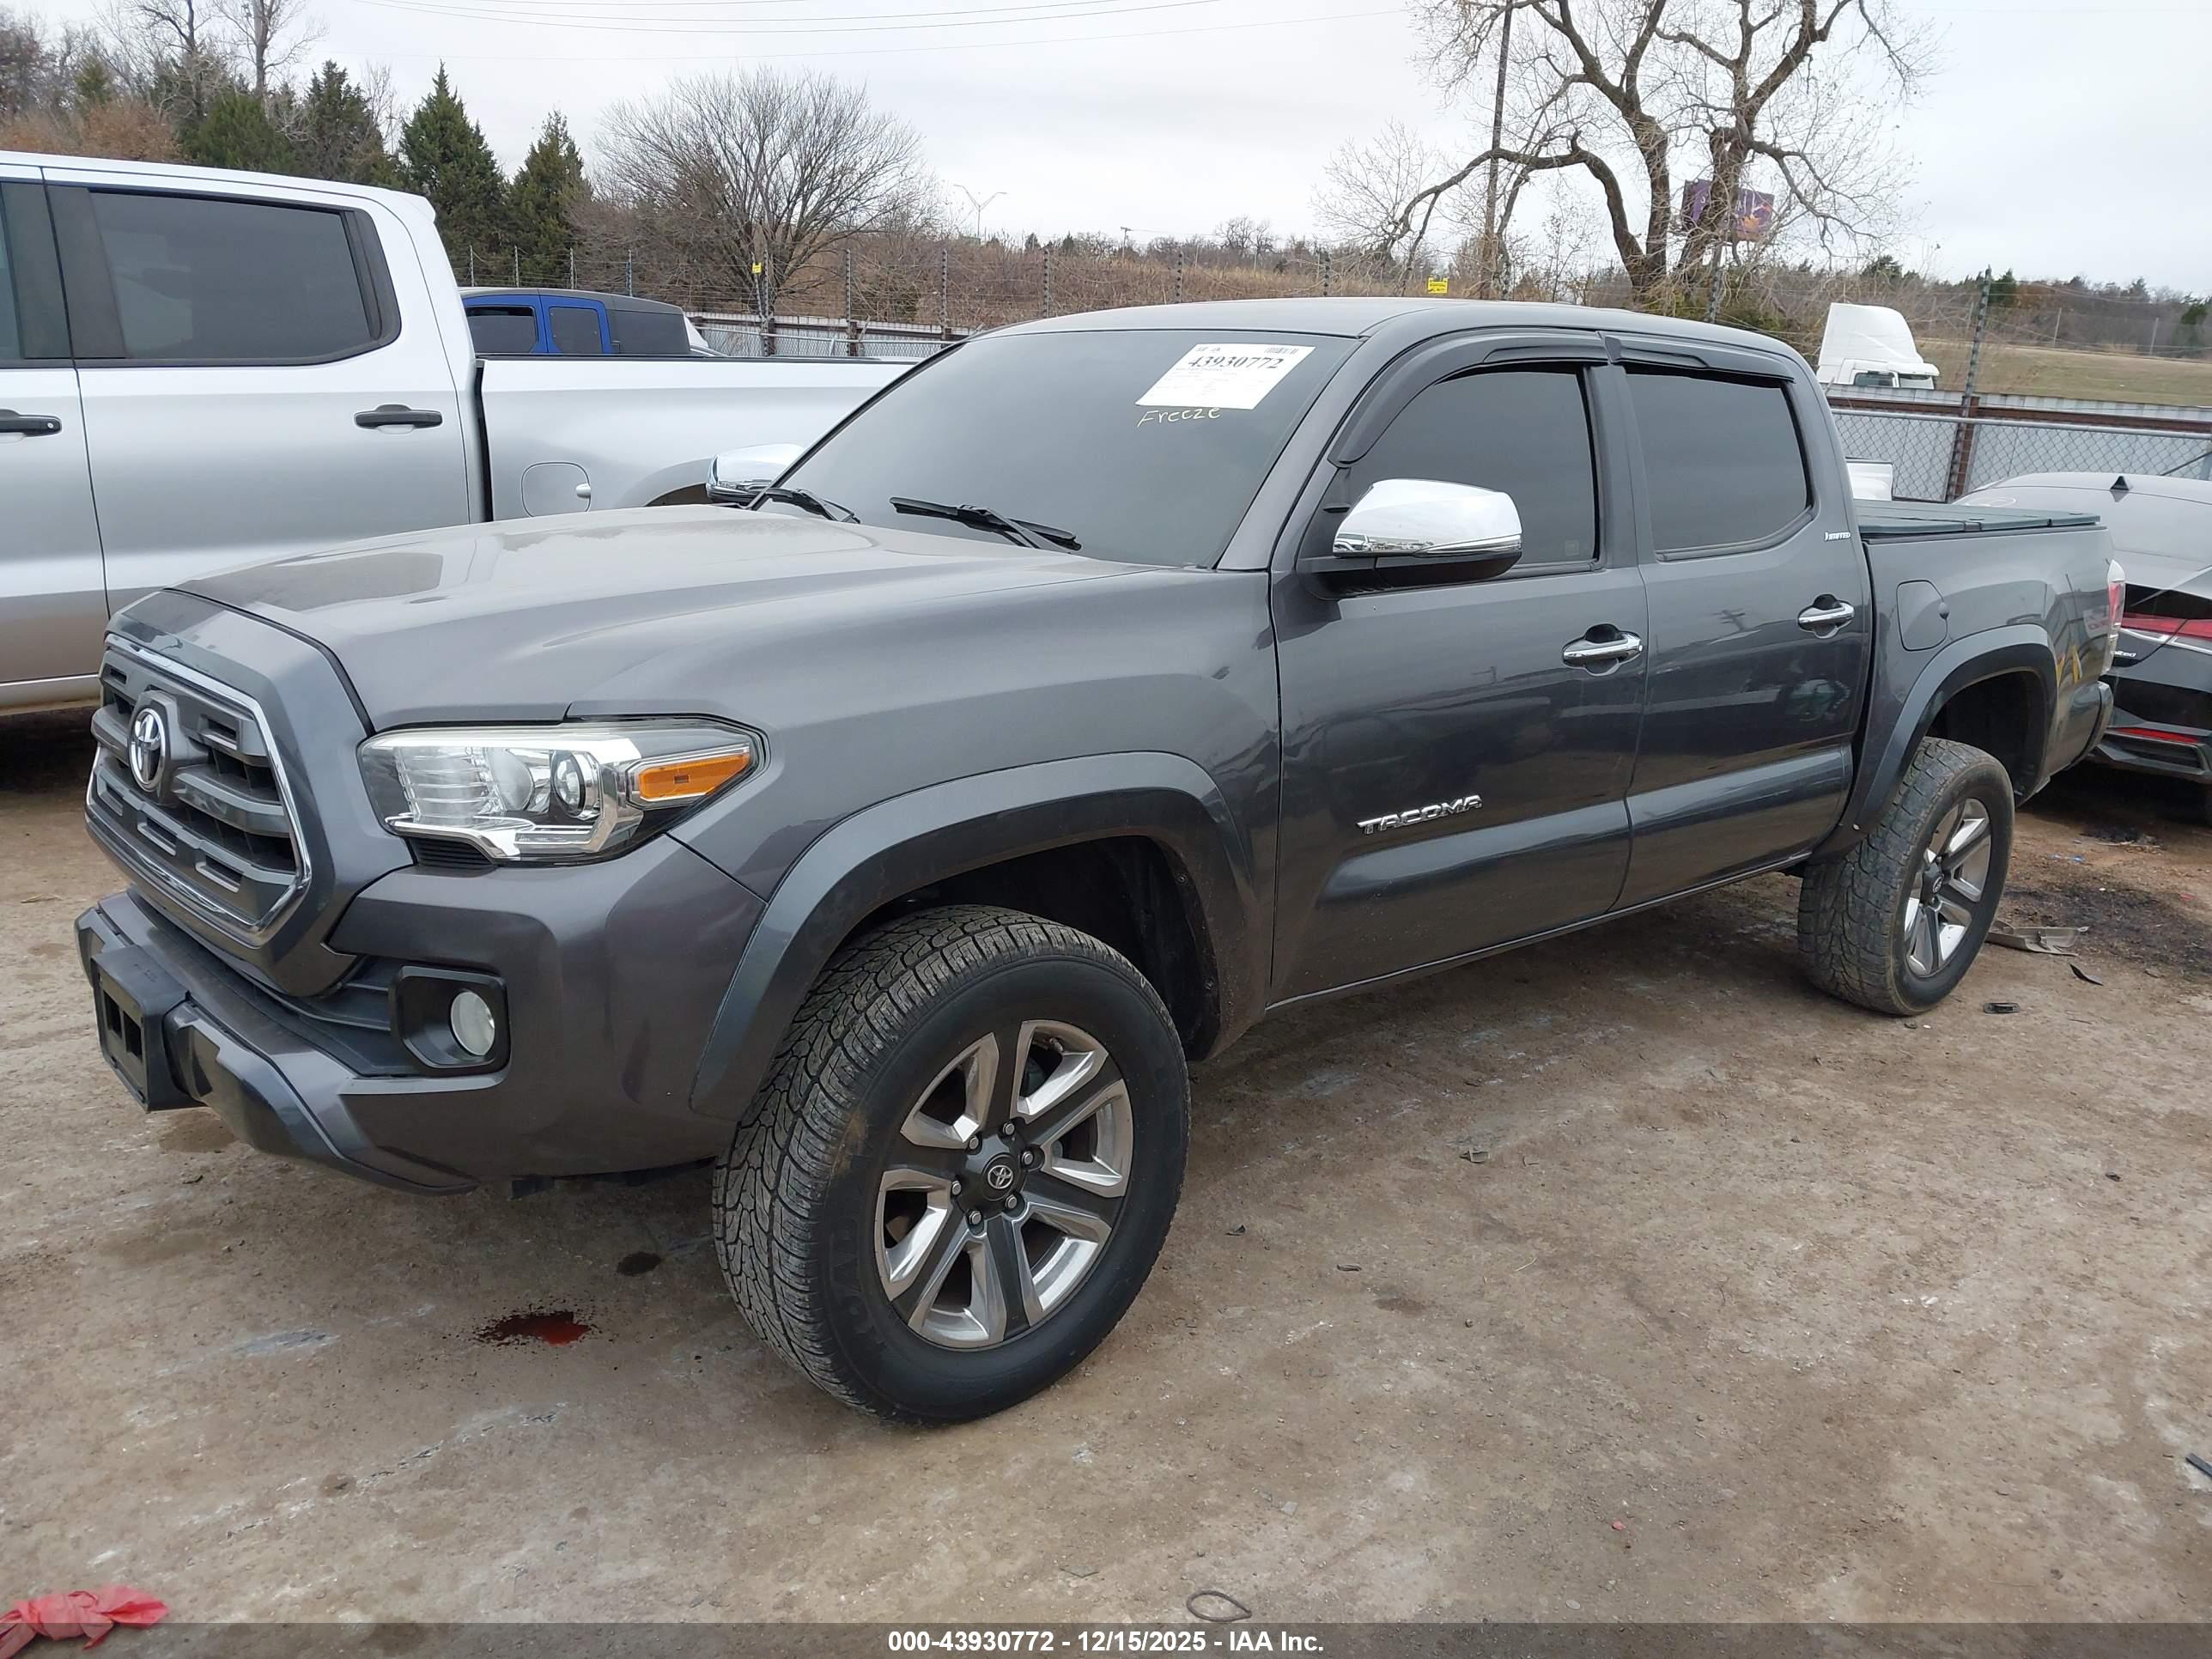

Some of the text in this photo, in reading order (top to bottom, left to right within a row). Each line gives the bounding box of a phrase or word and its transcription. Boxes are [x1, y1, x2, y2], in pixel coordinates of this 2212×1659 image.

[1188, 356, 1285, 369] 43930772
[1136, 407, 1222, 428] Freeze
[1356, 794, 1483, 835] TACOMA
